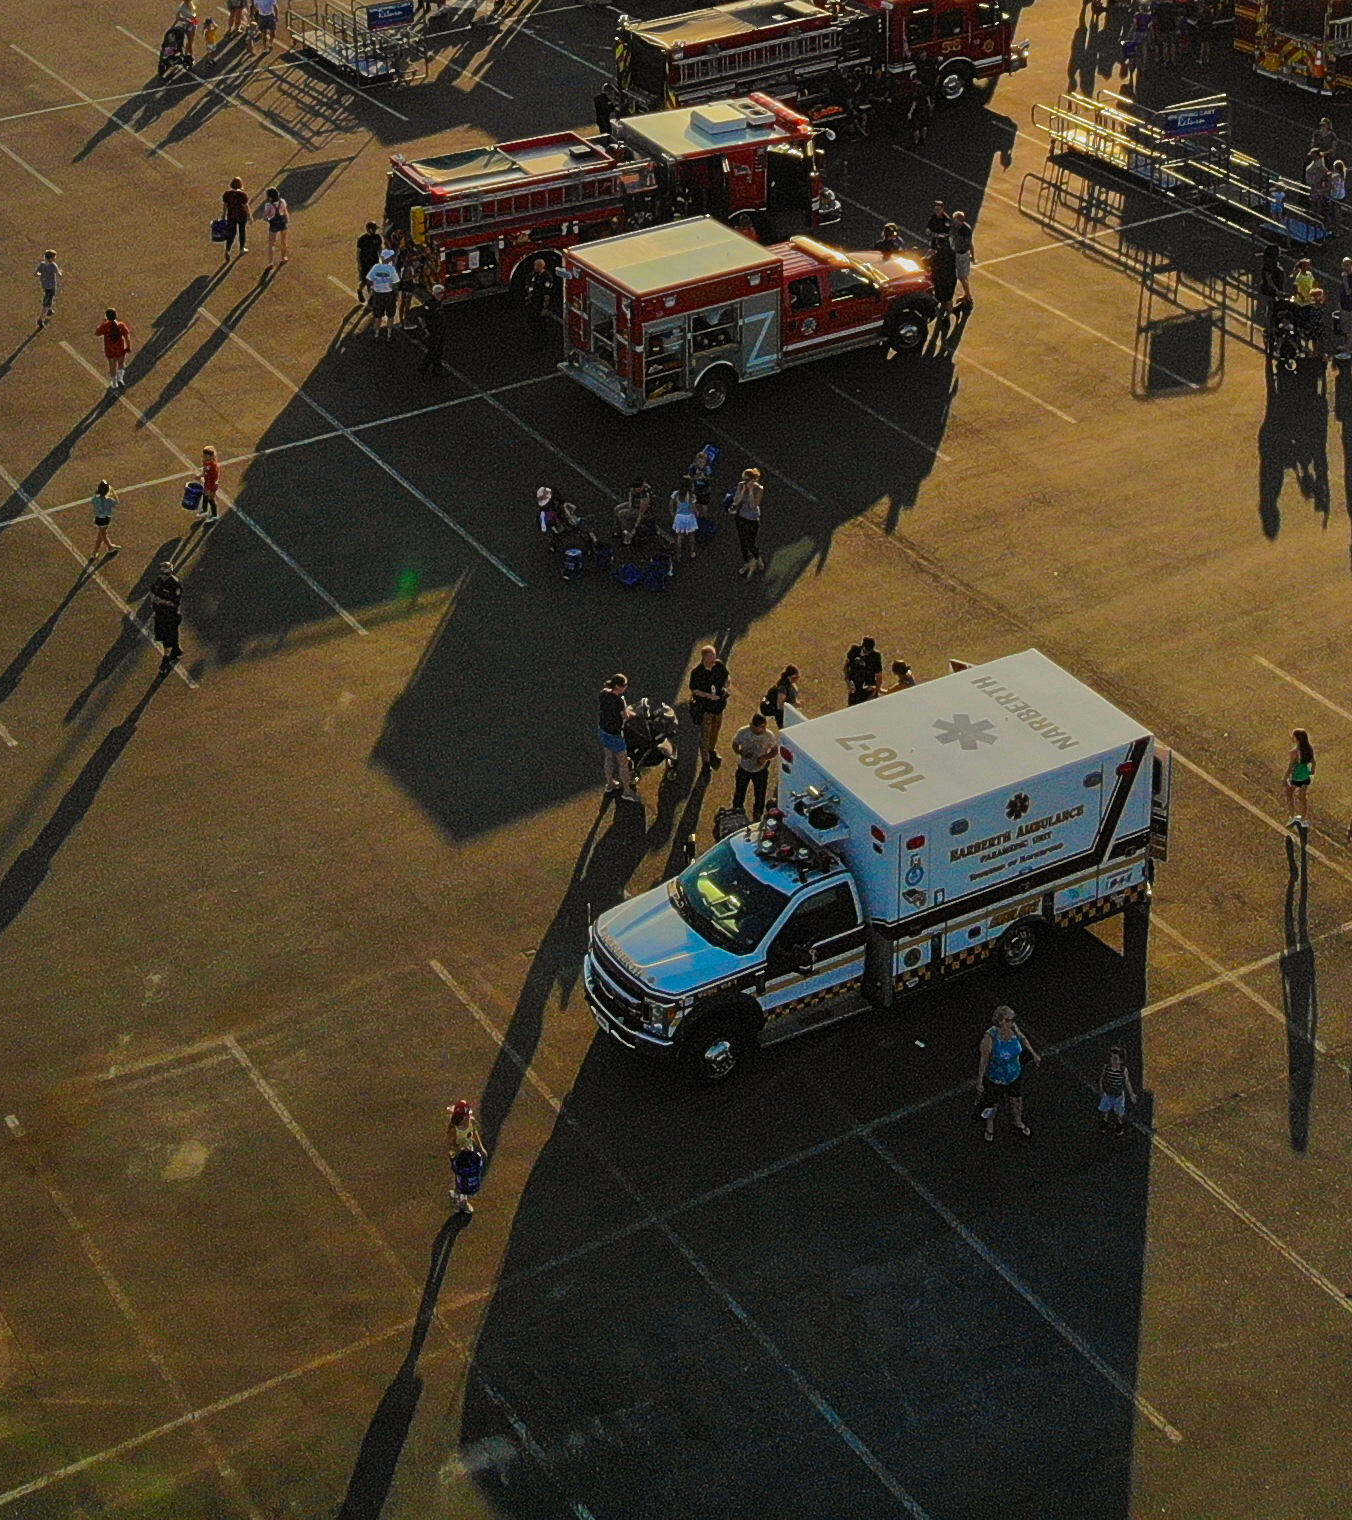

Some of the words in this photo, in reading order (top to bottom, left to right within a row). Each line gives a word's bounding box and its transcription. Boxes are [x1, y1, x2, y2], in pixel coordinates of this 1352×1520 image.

[971, 676, 1081, 751] NARBERTH
[835, 733, 927, 793] 108-7
[949, 829, 1012, 863] NARBERTH
[1015, 803, 1085, 840] AMBULANCE
